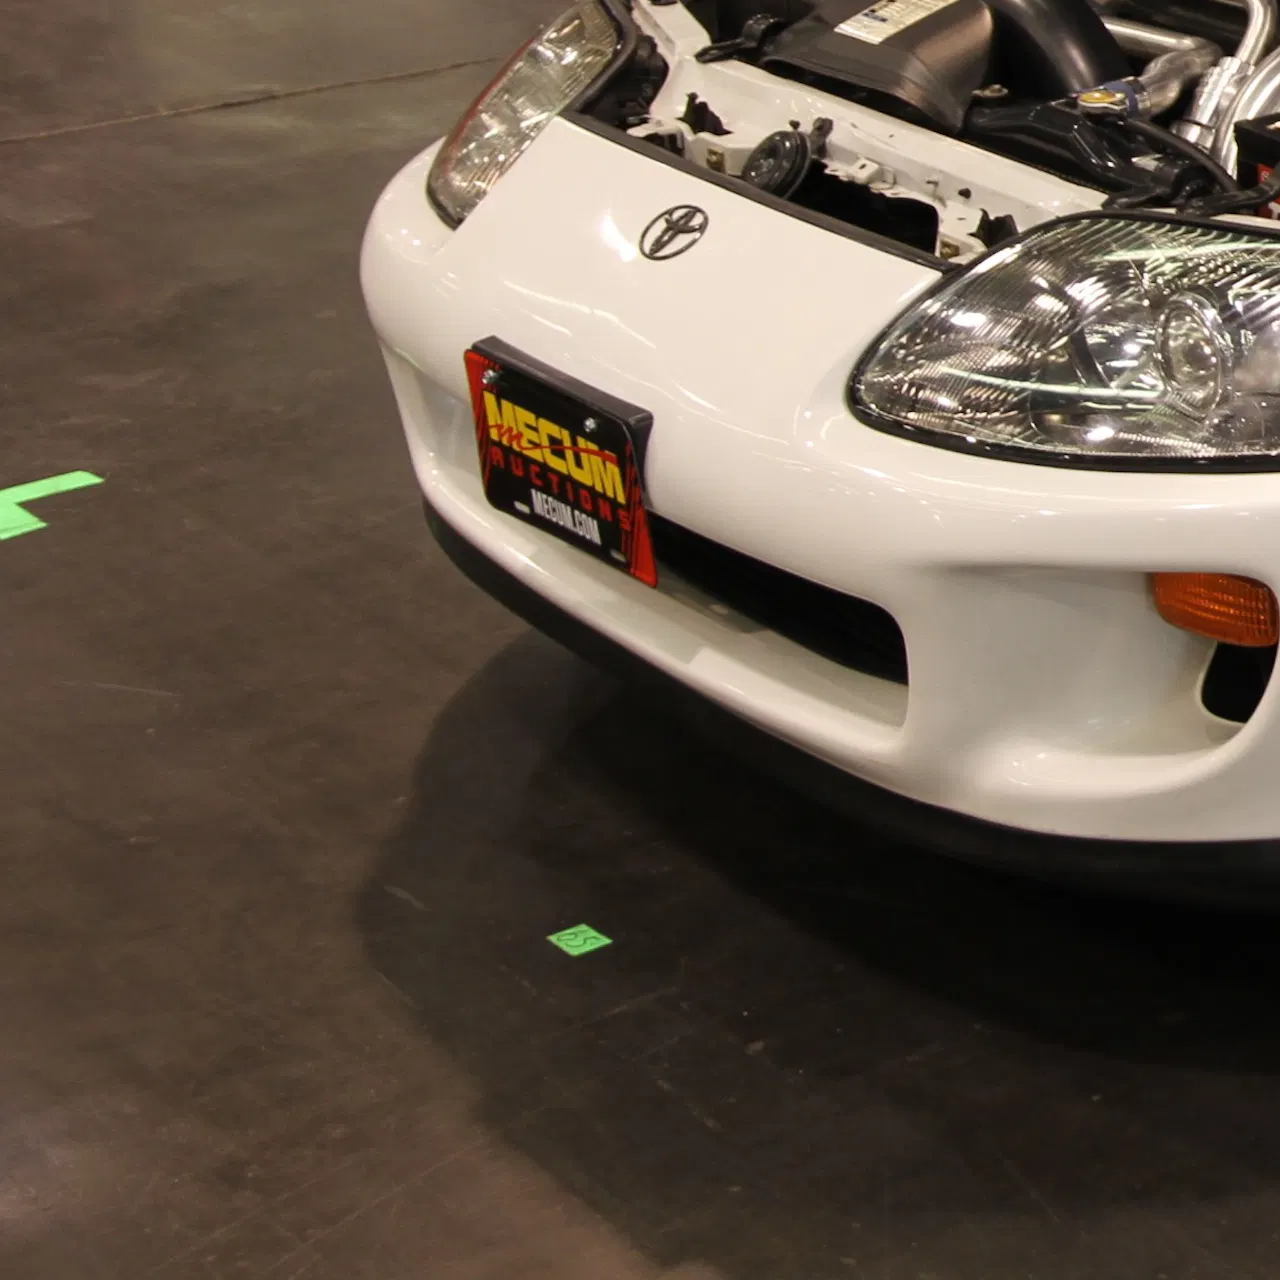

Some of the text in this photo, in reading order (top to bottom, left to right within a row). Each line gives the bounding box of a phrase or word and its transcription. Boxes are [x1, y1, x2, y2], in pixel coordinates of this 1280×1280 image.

[483, 391, 626, 505] MECUM
[490, 445, 631, 531] AUCTIONS
[530, 488, 602, 545] MECUM.COM
